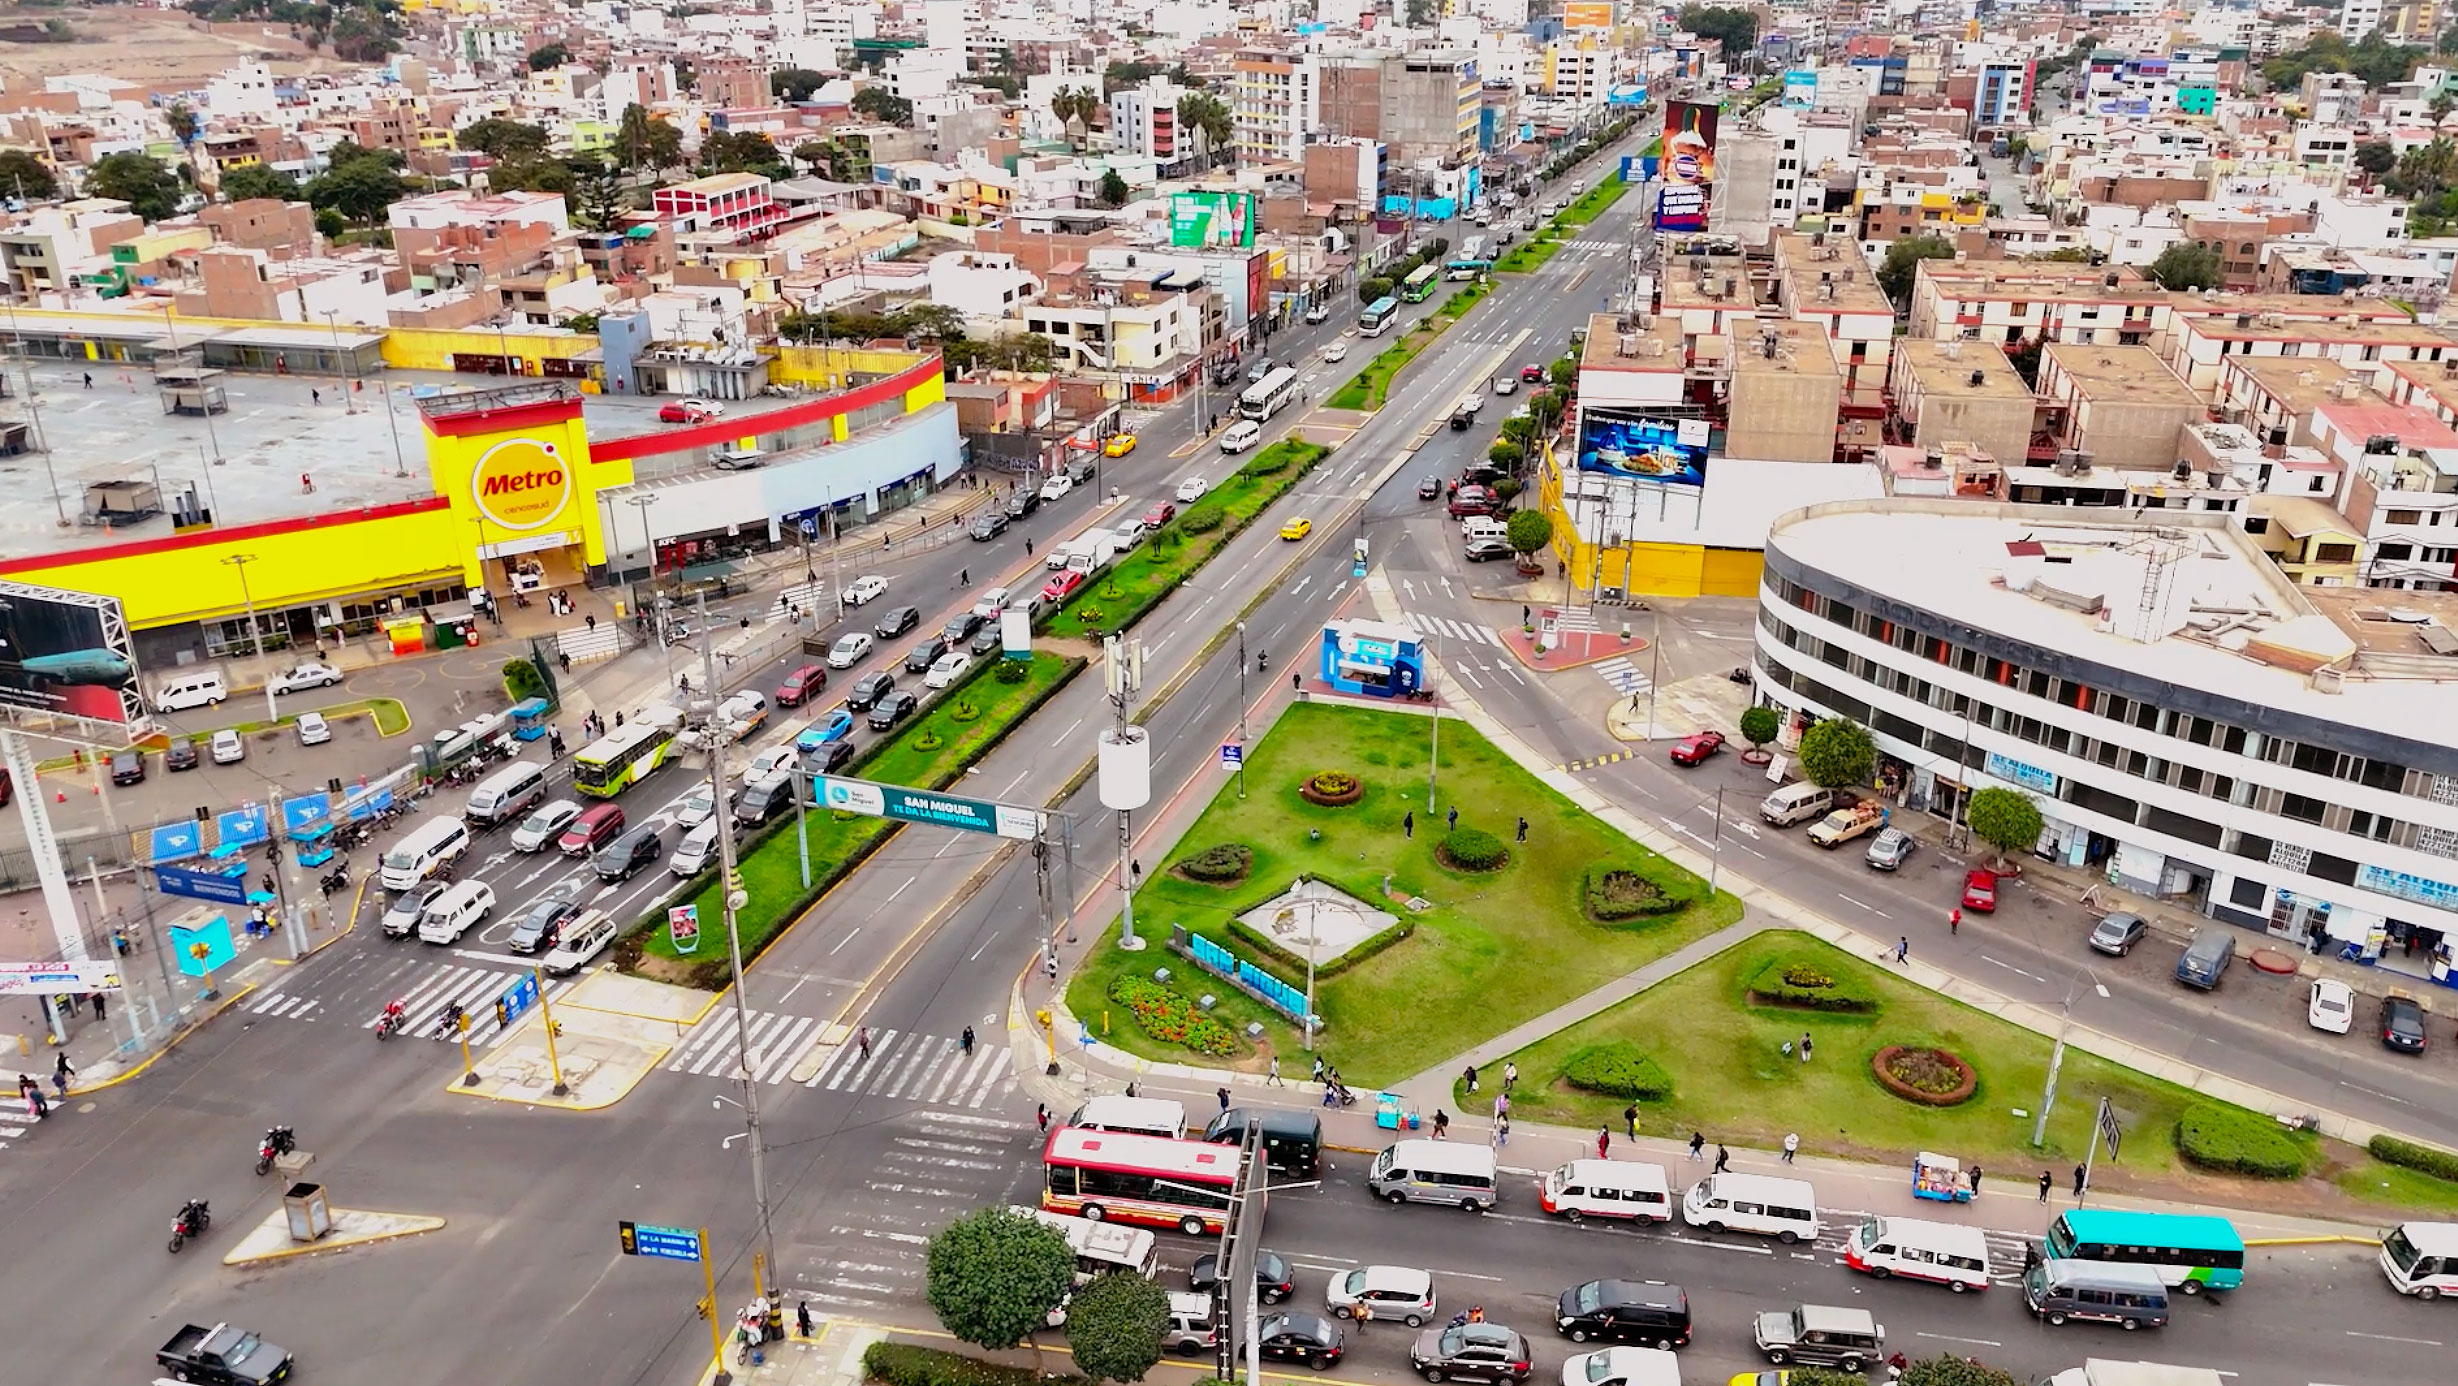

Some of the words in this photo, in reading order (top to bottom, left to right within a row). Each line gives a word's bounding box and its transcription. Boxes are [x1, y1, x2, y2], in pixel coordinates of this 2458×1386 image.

[483, 469, 563, 497] Metro
[504, 500, 551, 515] cencosud
[658, 537, 676, 547] KFC
[2008, 758, 2053, 779] ALQUILA
[892, 804, 905, 814] TE
[904, 806, 919, 817] DA
[918, 808, 932, 819] LA
[931, 810, 990, 828] BIENVENIDA
[903, 795, 930, 811] SAN
[929, 799, 976, 817] MIGUEL
[2274, 846, 2308, 862] ALQUILA
